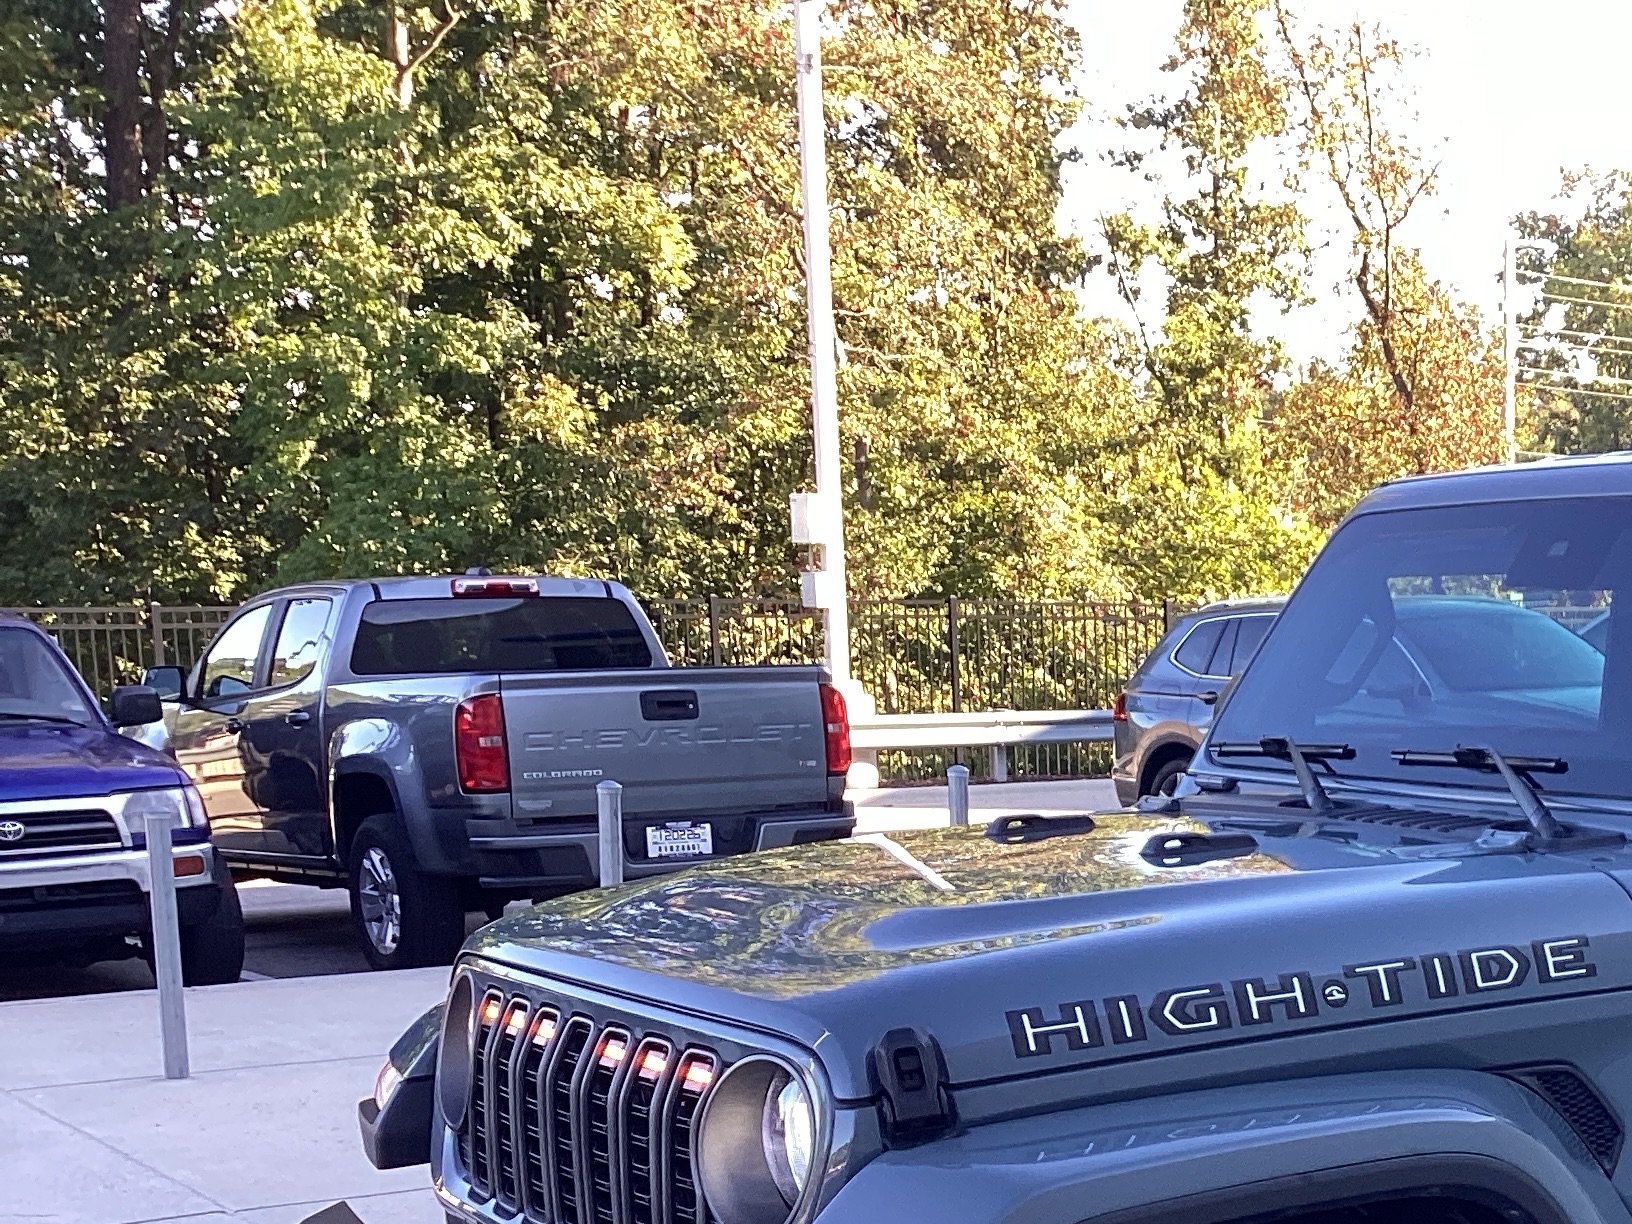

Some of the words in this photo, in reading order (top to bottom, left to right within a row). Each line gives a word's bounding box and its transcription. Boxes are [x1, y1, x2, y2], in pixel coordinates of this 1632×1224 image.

[522, 723, 812, 751] CHEVROLET
[522, 768, 603, 779] COLORADO
[1005, 970, 1326, 1059] HIGH
[1343, 934, 1598, 1008] TIDE
